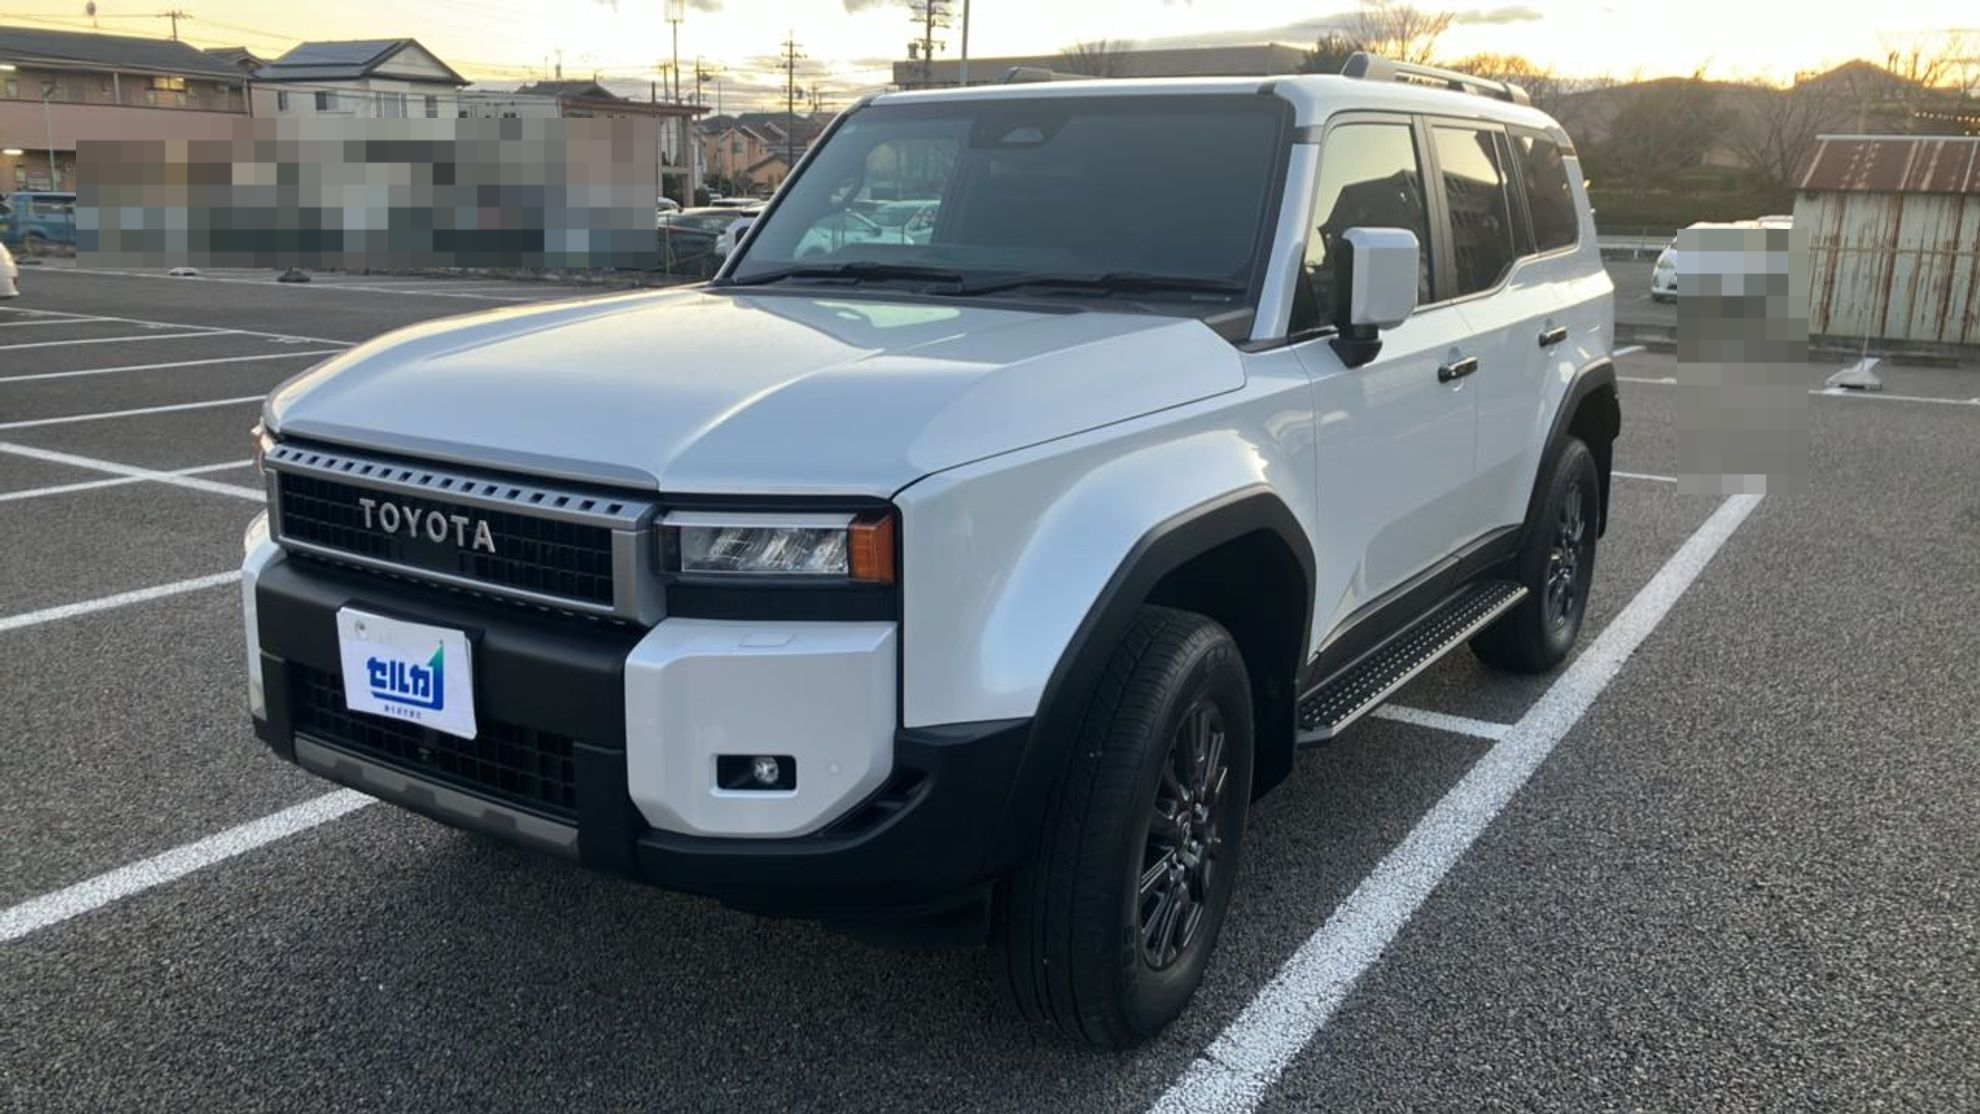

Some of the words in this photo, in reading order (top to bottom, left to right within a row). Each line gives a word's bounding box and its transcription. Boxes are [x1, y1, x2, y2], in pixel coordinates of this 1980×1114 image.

[359, 498, 496, 553] TOYOTA
[366, 656, 431, 698] セルカ
